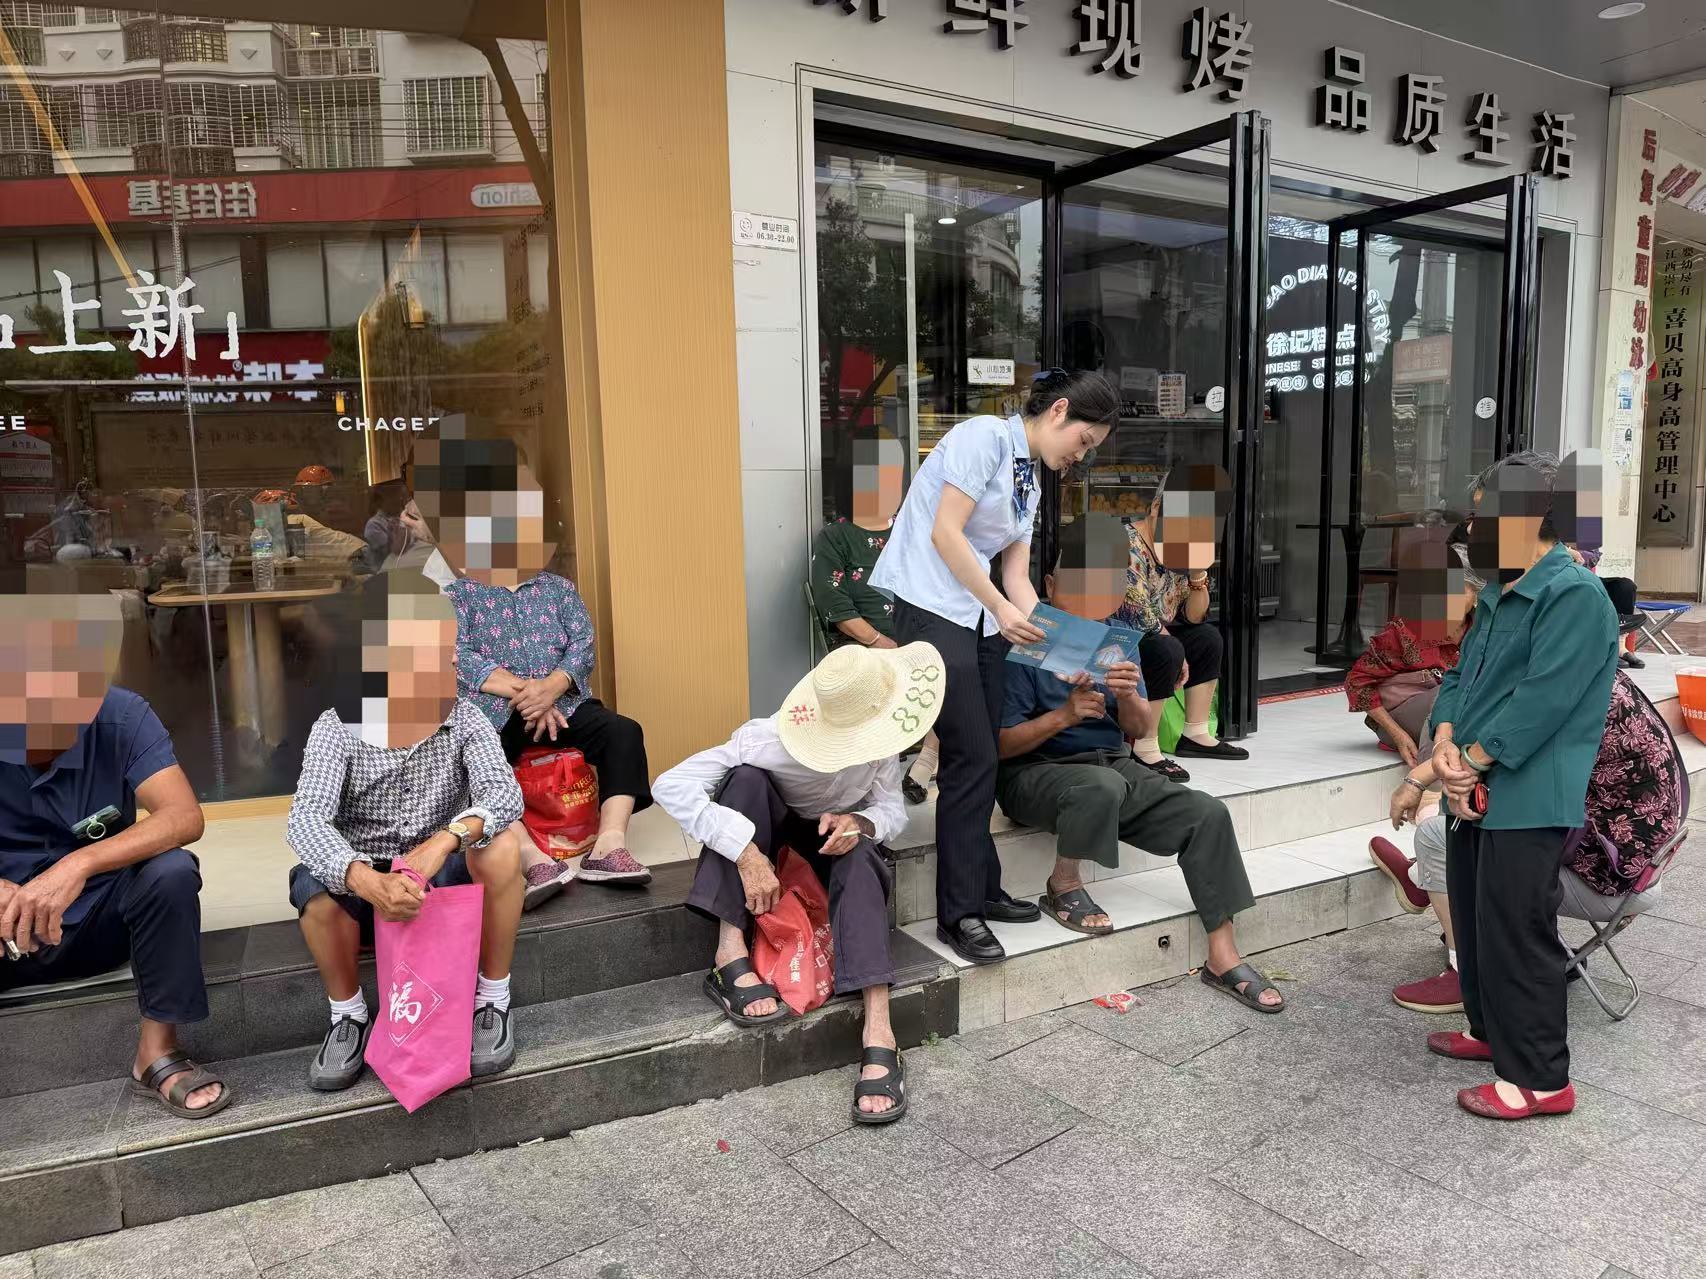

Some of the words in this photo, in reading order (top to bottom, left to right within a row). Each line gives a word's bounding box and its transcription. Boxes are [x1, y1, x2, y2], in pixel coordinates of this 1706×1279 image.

[1316, 46, 1577, 178] 品质生活
[0, 269, 239, 360] 上新」
[1651, 307, 1688, 523] 喜贝高身高管理中心
[387, 980, 423, 1025] 福
